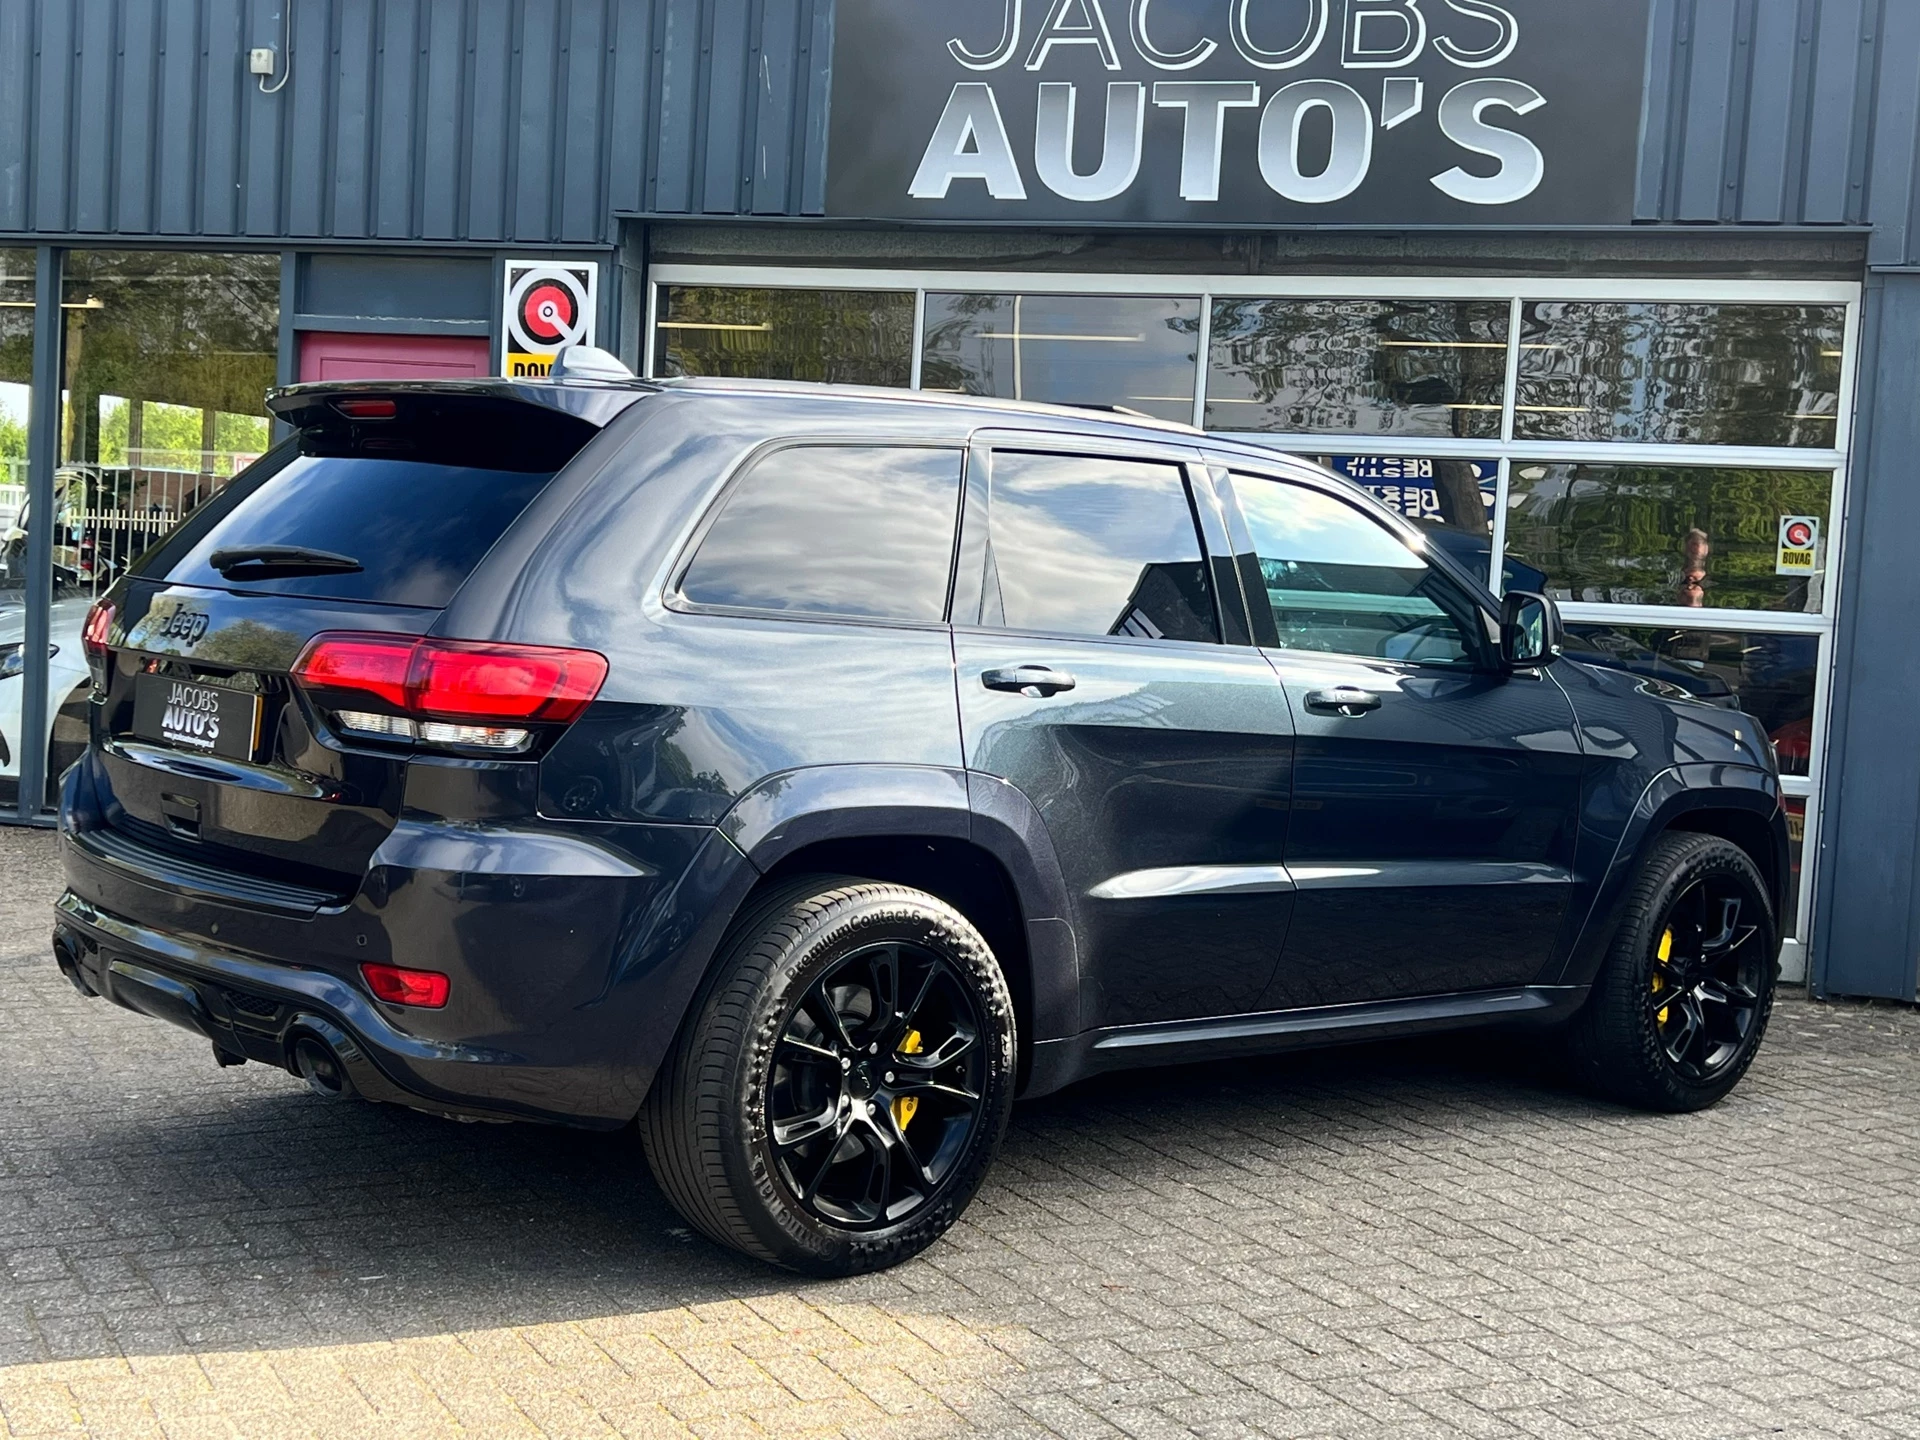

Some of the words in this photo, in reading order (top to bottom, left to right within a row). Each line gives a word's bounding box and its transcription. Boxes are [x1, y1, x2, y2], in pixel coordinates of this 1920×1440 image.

[946, 0, 1519, 71] JACOBS
[907, 77, 1547, 205] AUTO'S
[1782, 551, 1811, 566] BOVAG
[159, 603, 210, 648] Jeep
[167, 682, 219, 713] JACOBS
[161, 705, 220, 739] AUTO'S
